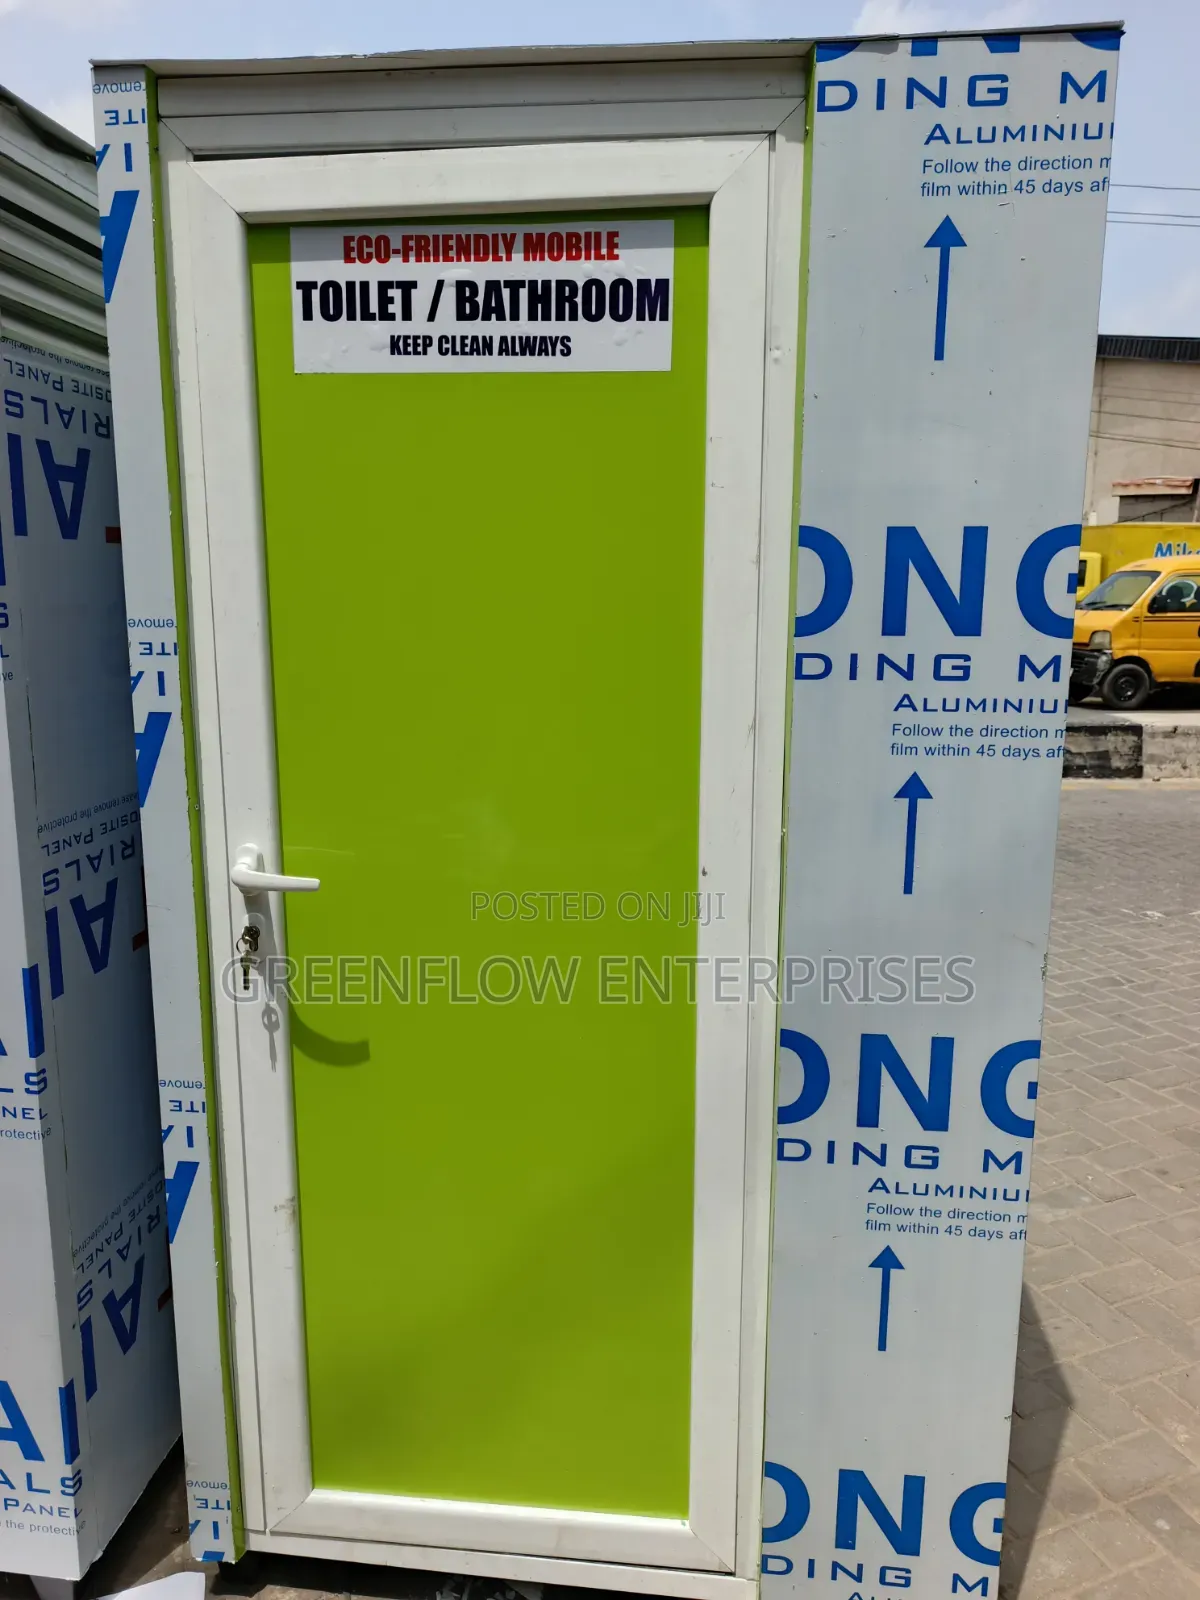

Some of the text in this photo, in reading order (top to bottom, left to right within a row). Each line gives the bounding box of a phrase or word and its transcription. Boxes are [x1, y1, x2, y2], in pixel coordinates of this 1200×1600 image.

[817, 70, 1107, 112] DING M
[924, 122, 1114, 145] ALUMINIU
[922, 158, 978, 174] Follow
[985, 157, 1011, 172] the
[1018, 155, 1093, 171] direction
[921, 182, 951, 197] film
[957, 181, 1008, 195] within
[1014, 180, 1036, 194] 45
[1042, 178, 1084, 196] days
[343, 231, 620, 264] ECO-FRIENDLY MOBILE
[296, 278, 669, 322] TOILET / BATHROOM
[390, 335, 572, 357] KEEP CLEAN ALWAYS
[4, 358, 64, 392] PANEL
[795, 653, 1062, 682] DING M
[893, 693, 1069, 714] ALUMINIU
[892, 724, 944, 737] Follow
[949, 724, 973, 738] the
[980, 724, 1048, 738] direction
[890, 743, 918, 756] film
[925, 744, 970, 756] within
[976, 744, 996, 757] 45
[1002, 744, 1039, 760] days
[80, 809, 92, 819] the
[41, 828, 93, 856] PANEL
[42, 835, 135, 896] RIALS
[777, 1138, 1022, 1174] DING M
[868, 1178, 1029, 1202] ALUMINIU
[866, 1203, 914, 1216] Follow
[919, 1206, 942, 1218] the
[947, 1208, 1011, 1223] direction
[866, 1220, 891, 1232] film
[896, 1222, 939, 1234] within
[944, 1224, 962, 1236] 45
[968, 1226, 1003, 1241] days
[77, 1221, 124, 1273] PANEL
[186, 1480, 228, 1490] emove
[4, 1498, 82, 1518] PANEL
[6, 1520, 24, 1530] the
[761, 1554, 989, 1596] DING M
